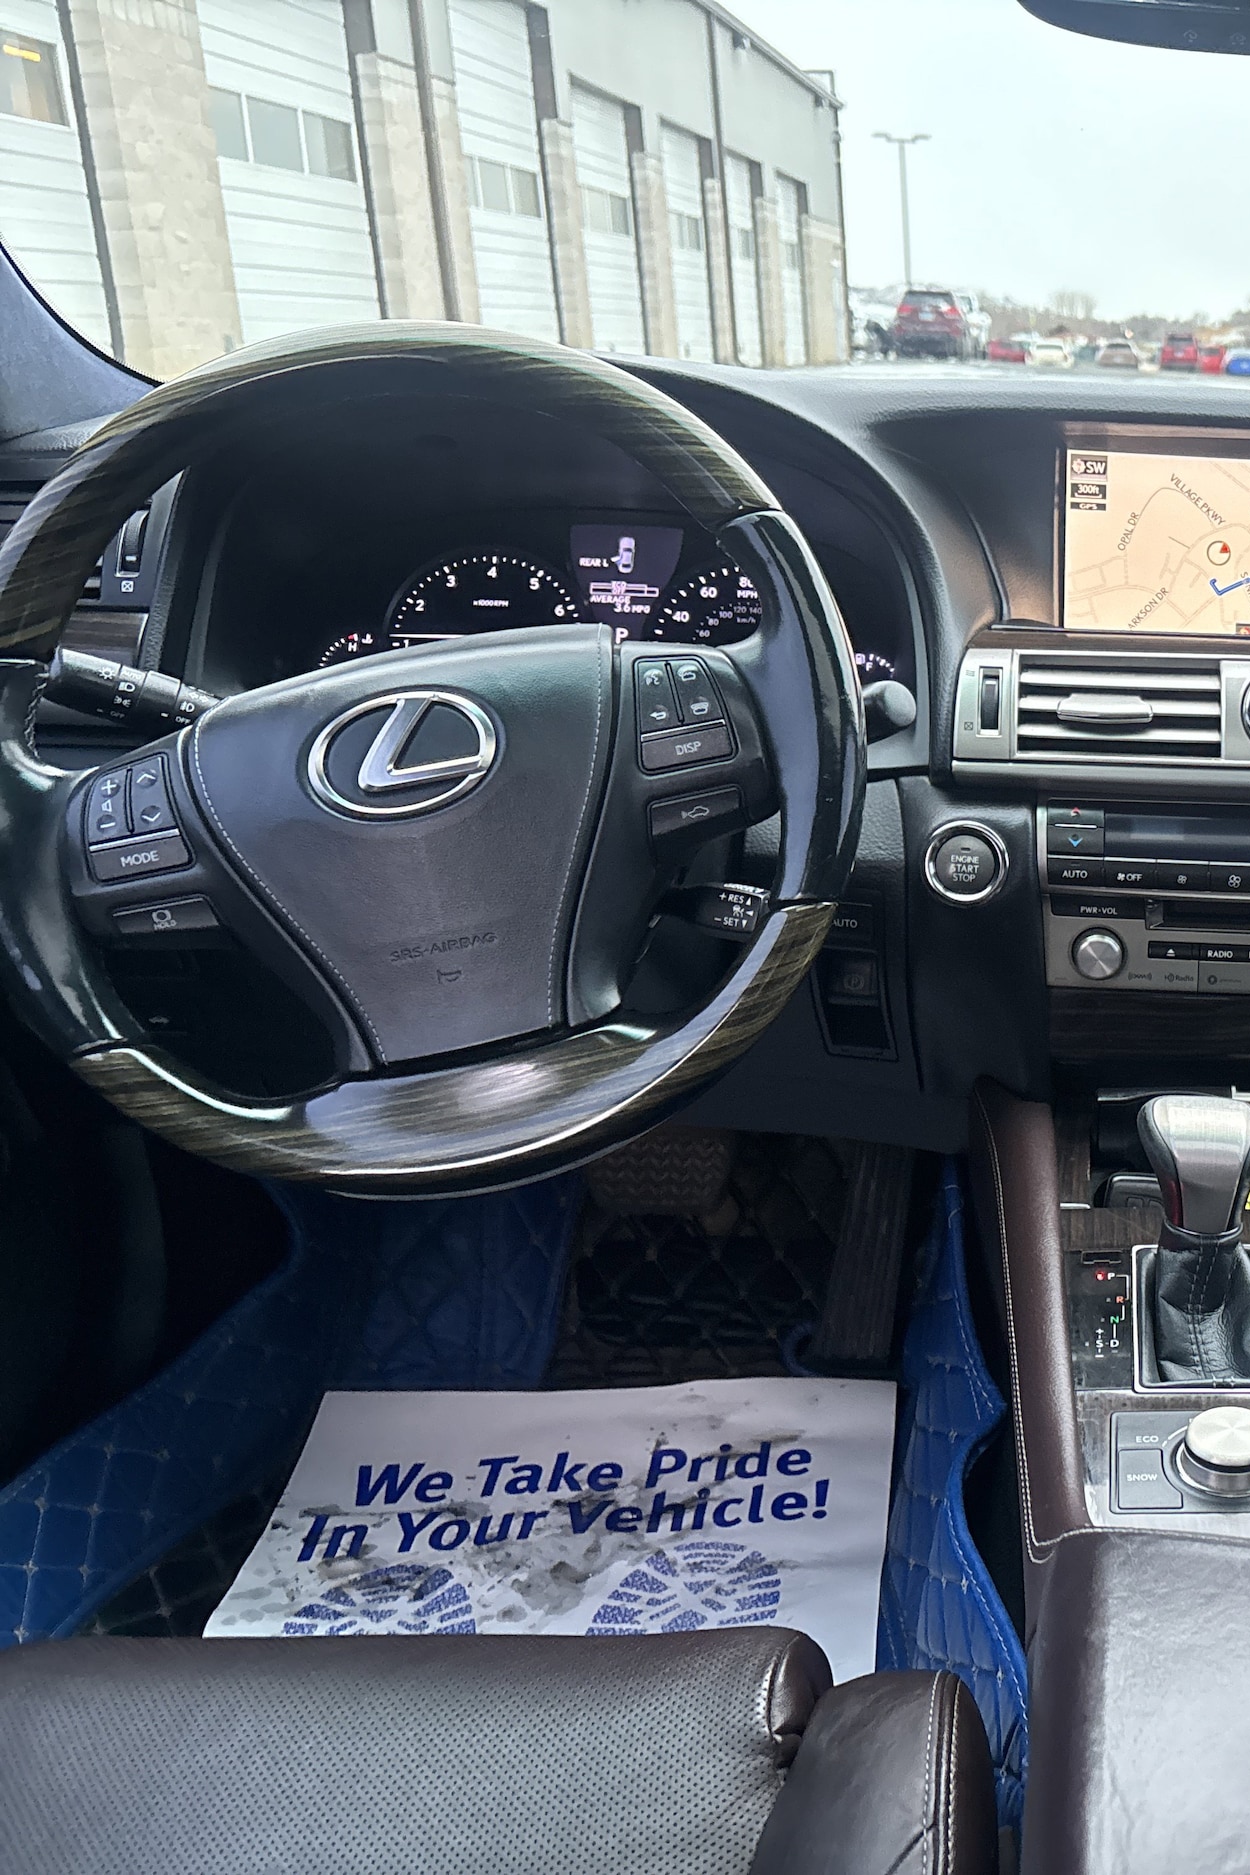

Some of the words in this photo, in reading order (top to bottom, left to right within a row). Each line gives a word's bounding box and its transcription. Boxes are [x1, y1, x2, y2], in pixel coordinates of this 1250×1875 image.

[1085, 461, 1106, 474] SW
[1077, 484, 1100, 495] 300ft
[1170, 473, 1203, 507] VILLAGE
[1199, 502, 1226, 526] PKWY
[1117, 527, 1134, 551] OPAL
[1128, 511, 1140, 526] DR
[579, 557, 601, 567] REAR
[603, 558, 609, 567] L
[487, 566, 498, 578] 4
[446, 575, 457, 587] 3
[529, 577, 540, 590] 5
[700, 587, 717, 598] 60
[737, 590, 758, 599] MPH
[1155, 587, 1169, 603] DR
[590, 595, 631, 604] AVERAGE
[415, 599, 425, 612] 2
[554, 604, 565, 617] 6
[613, 602, 631, 613] 3.6
[733, 605, 747, 614] 120
[749, 606, 762, 614] 140
[672, 610, 689, 622] 40
[719, 610, 733, 619] 100
[708, 618, 719, 626] 80
[736, 616, 756, 624] km/h
[615, 627, 629, 644] P
[699, 629, 710, 637] 60
[348, 642, 357, 652] H
[865, 661, 873, 671] F
[175, 715, 191, 724] OFF
[674, 740, 702, 755] DISP
[120, 850, 160, 868] MODE
[950, 854, 980, 864] ENGINE
[950, 863, 980, 873] START
[952, 873, 976, 882] STOP
[1062, 870, 1088, 879] AUTO
[1126, 873, 1143, 882] OFF
[728, 893, 745, 904] RES
[723, 917, 739, 927] SET
[1207, 949, 1234, 959] RADIO
[1175, 975, 1195, 983] Radio
[1107, 1272, 1115, 1280] P
[1110, 1315, 1119, 1323] N
[1096, 1340, 1104, 1348] S
[1110, 1340, 1119, 1348] D
[1135, 1435, 1159, 1443] ECO
[355, 1461, 453, 1506] We
[479, 1451, 624, 1497] Take
[644, 1441, 812, 1489] Pride
[1126, 1474, 1158, 1482] SNOW
[296, 1514, 369, 1562] In
[396, 1508, 548, 1553] Your
[564, 1479, 830, 1536] Vehicle!
